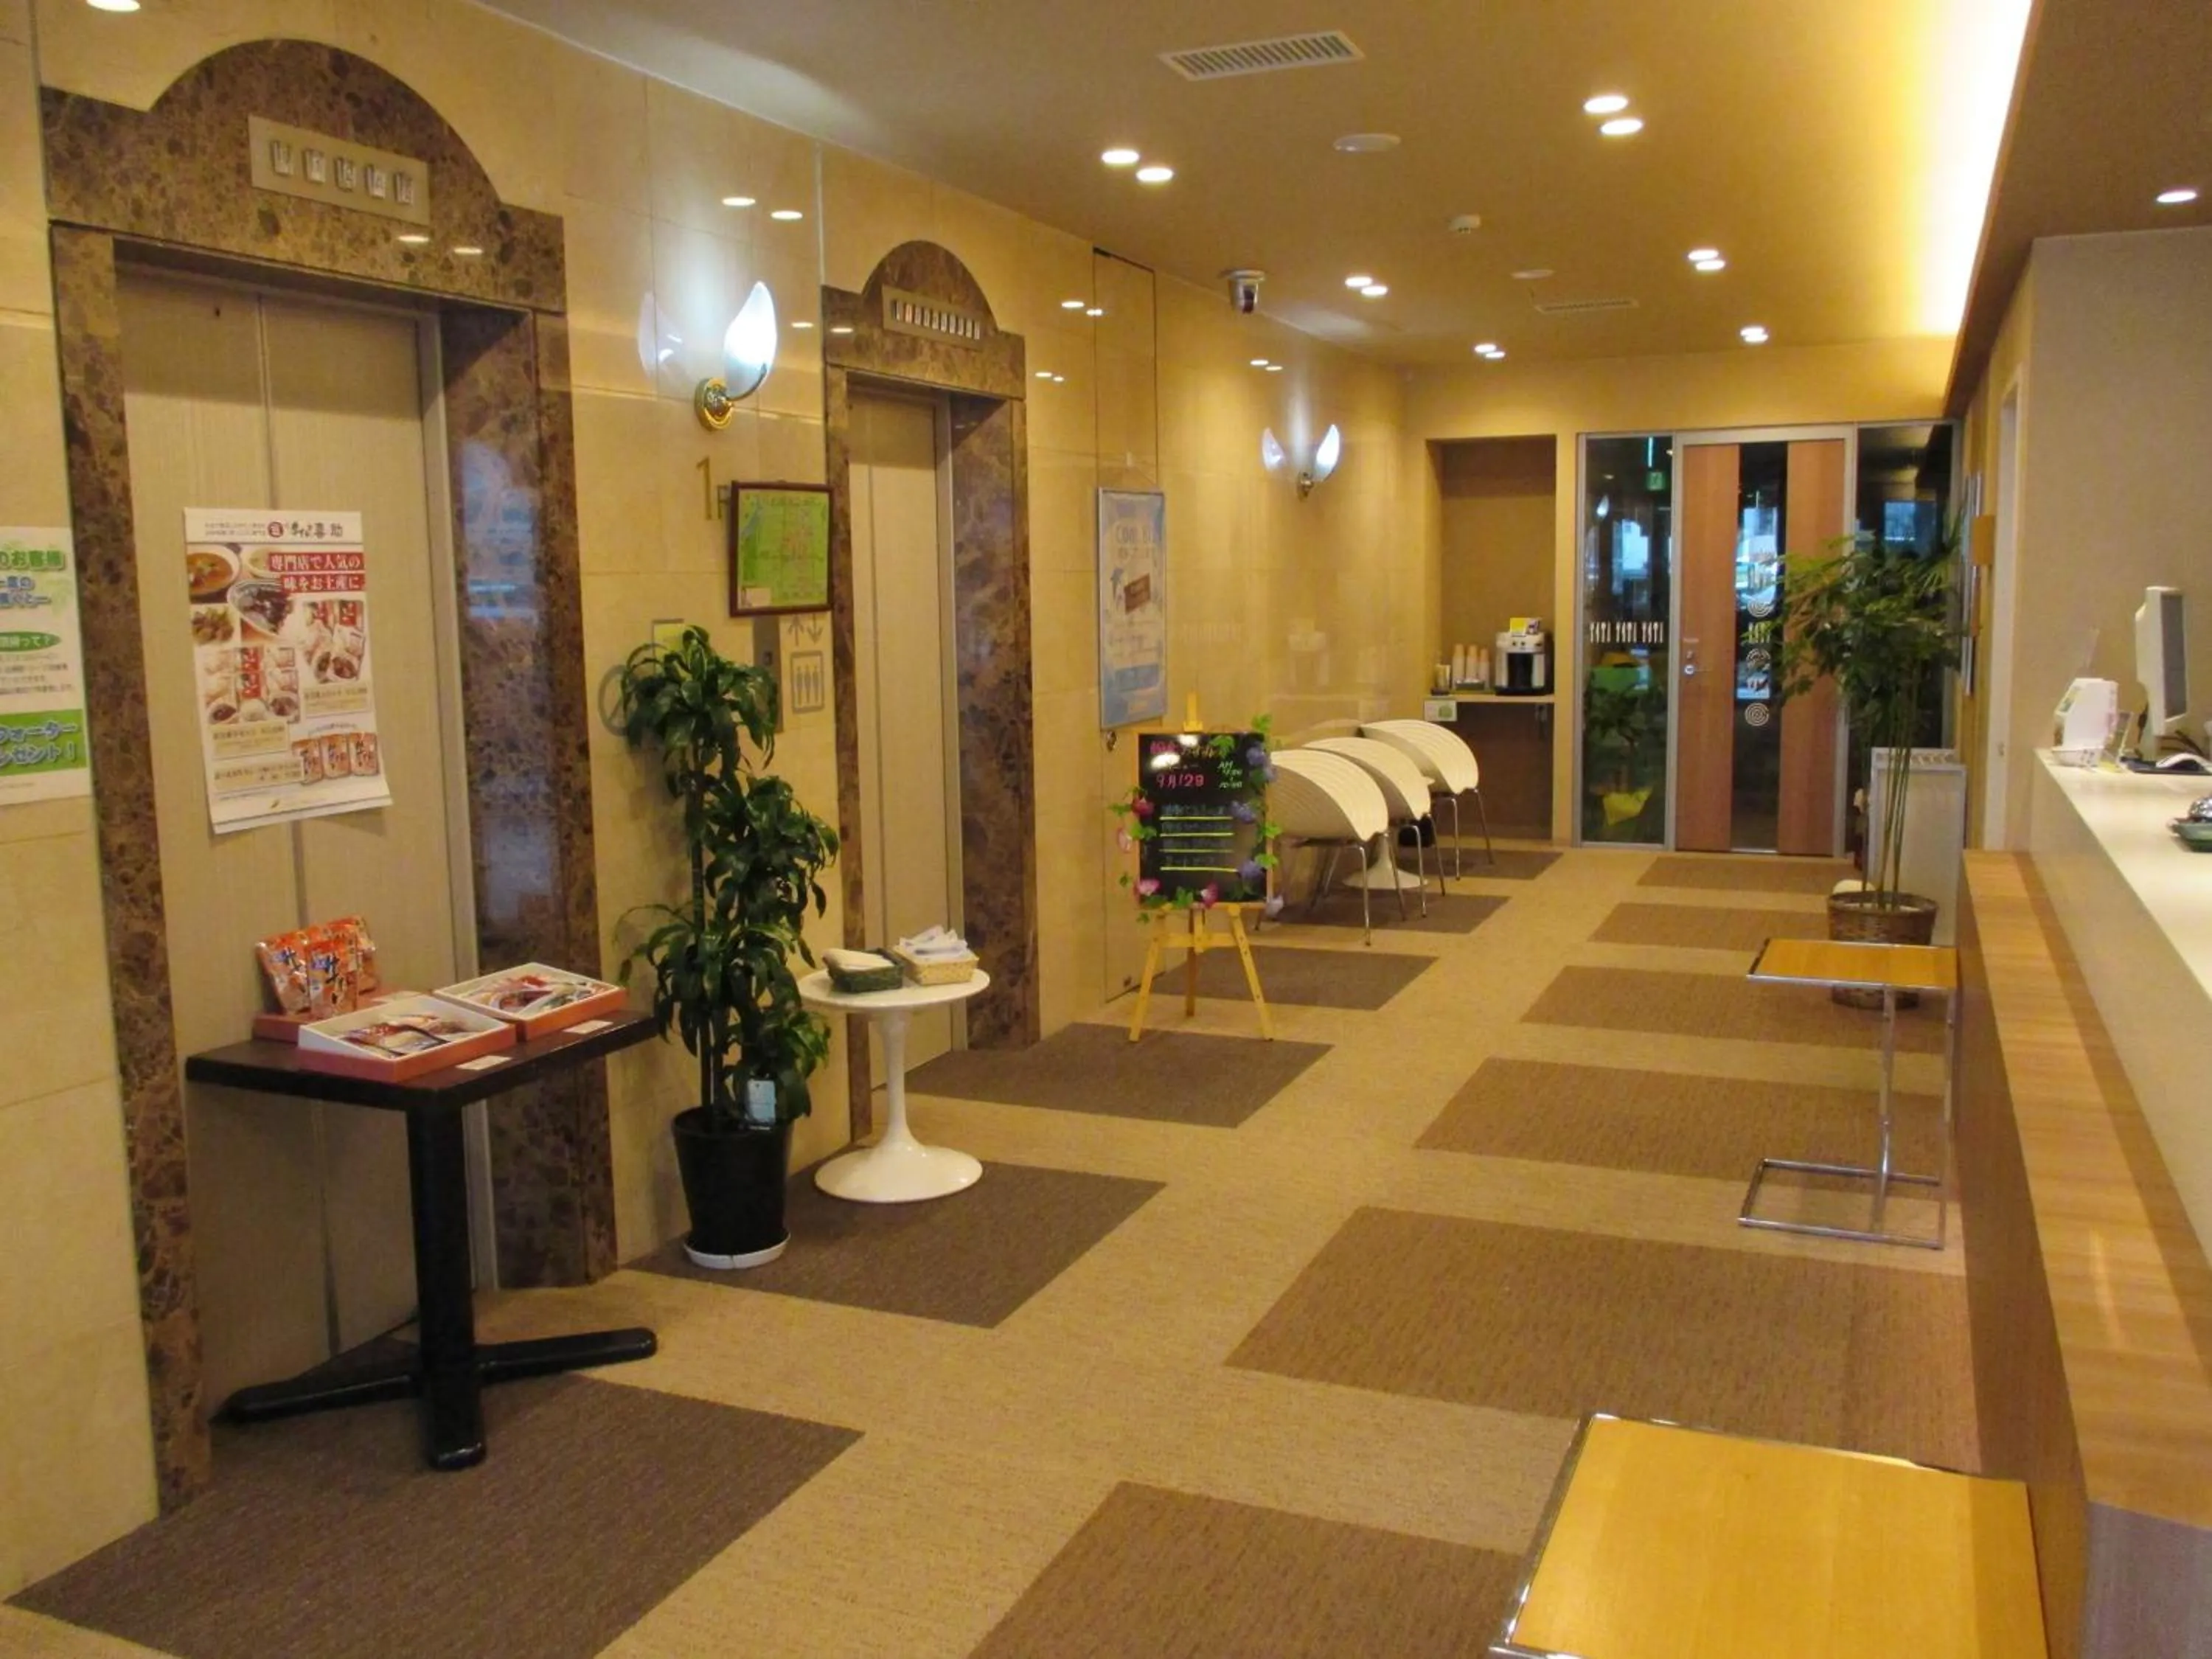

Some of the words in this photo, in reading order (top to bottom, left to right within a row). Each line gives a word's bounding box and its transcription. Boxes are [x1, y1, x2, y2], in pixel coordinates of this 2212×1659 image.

[271, 553, 361, 571] 専門店で人気の
[283, 574, 361, 593] 味をお土産に
